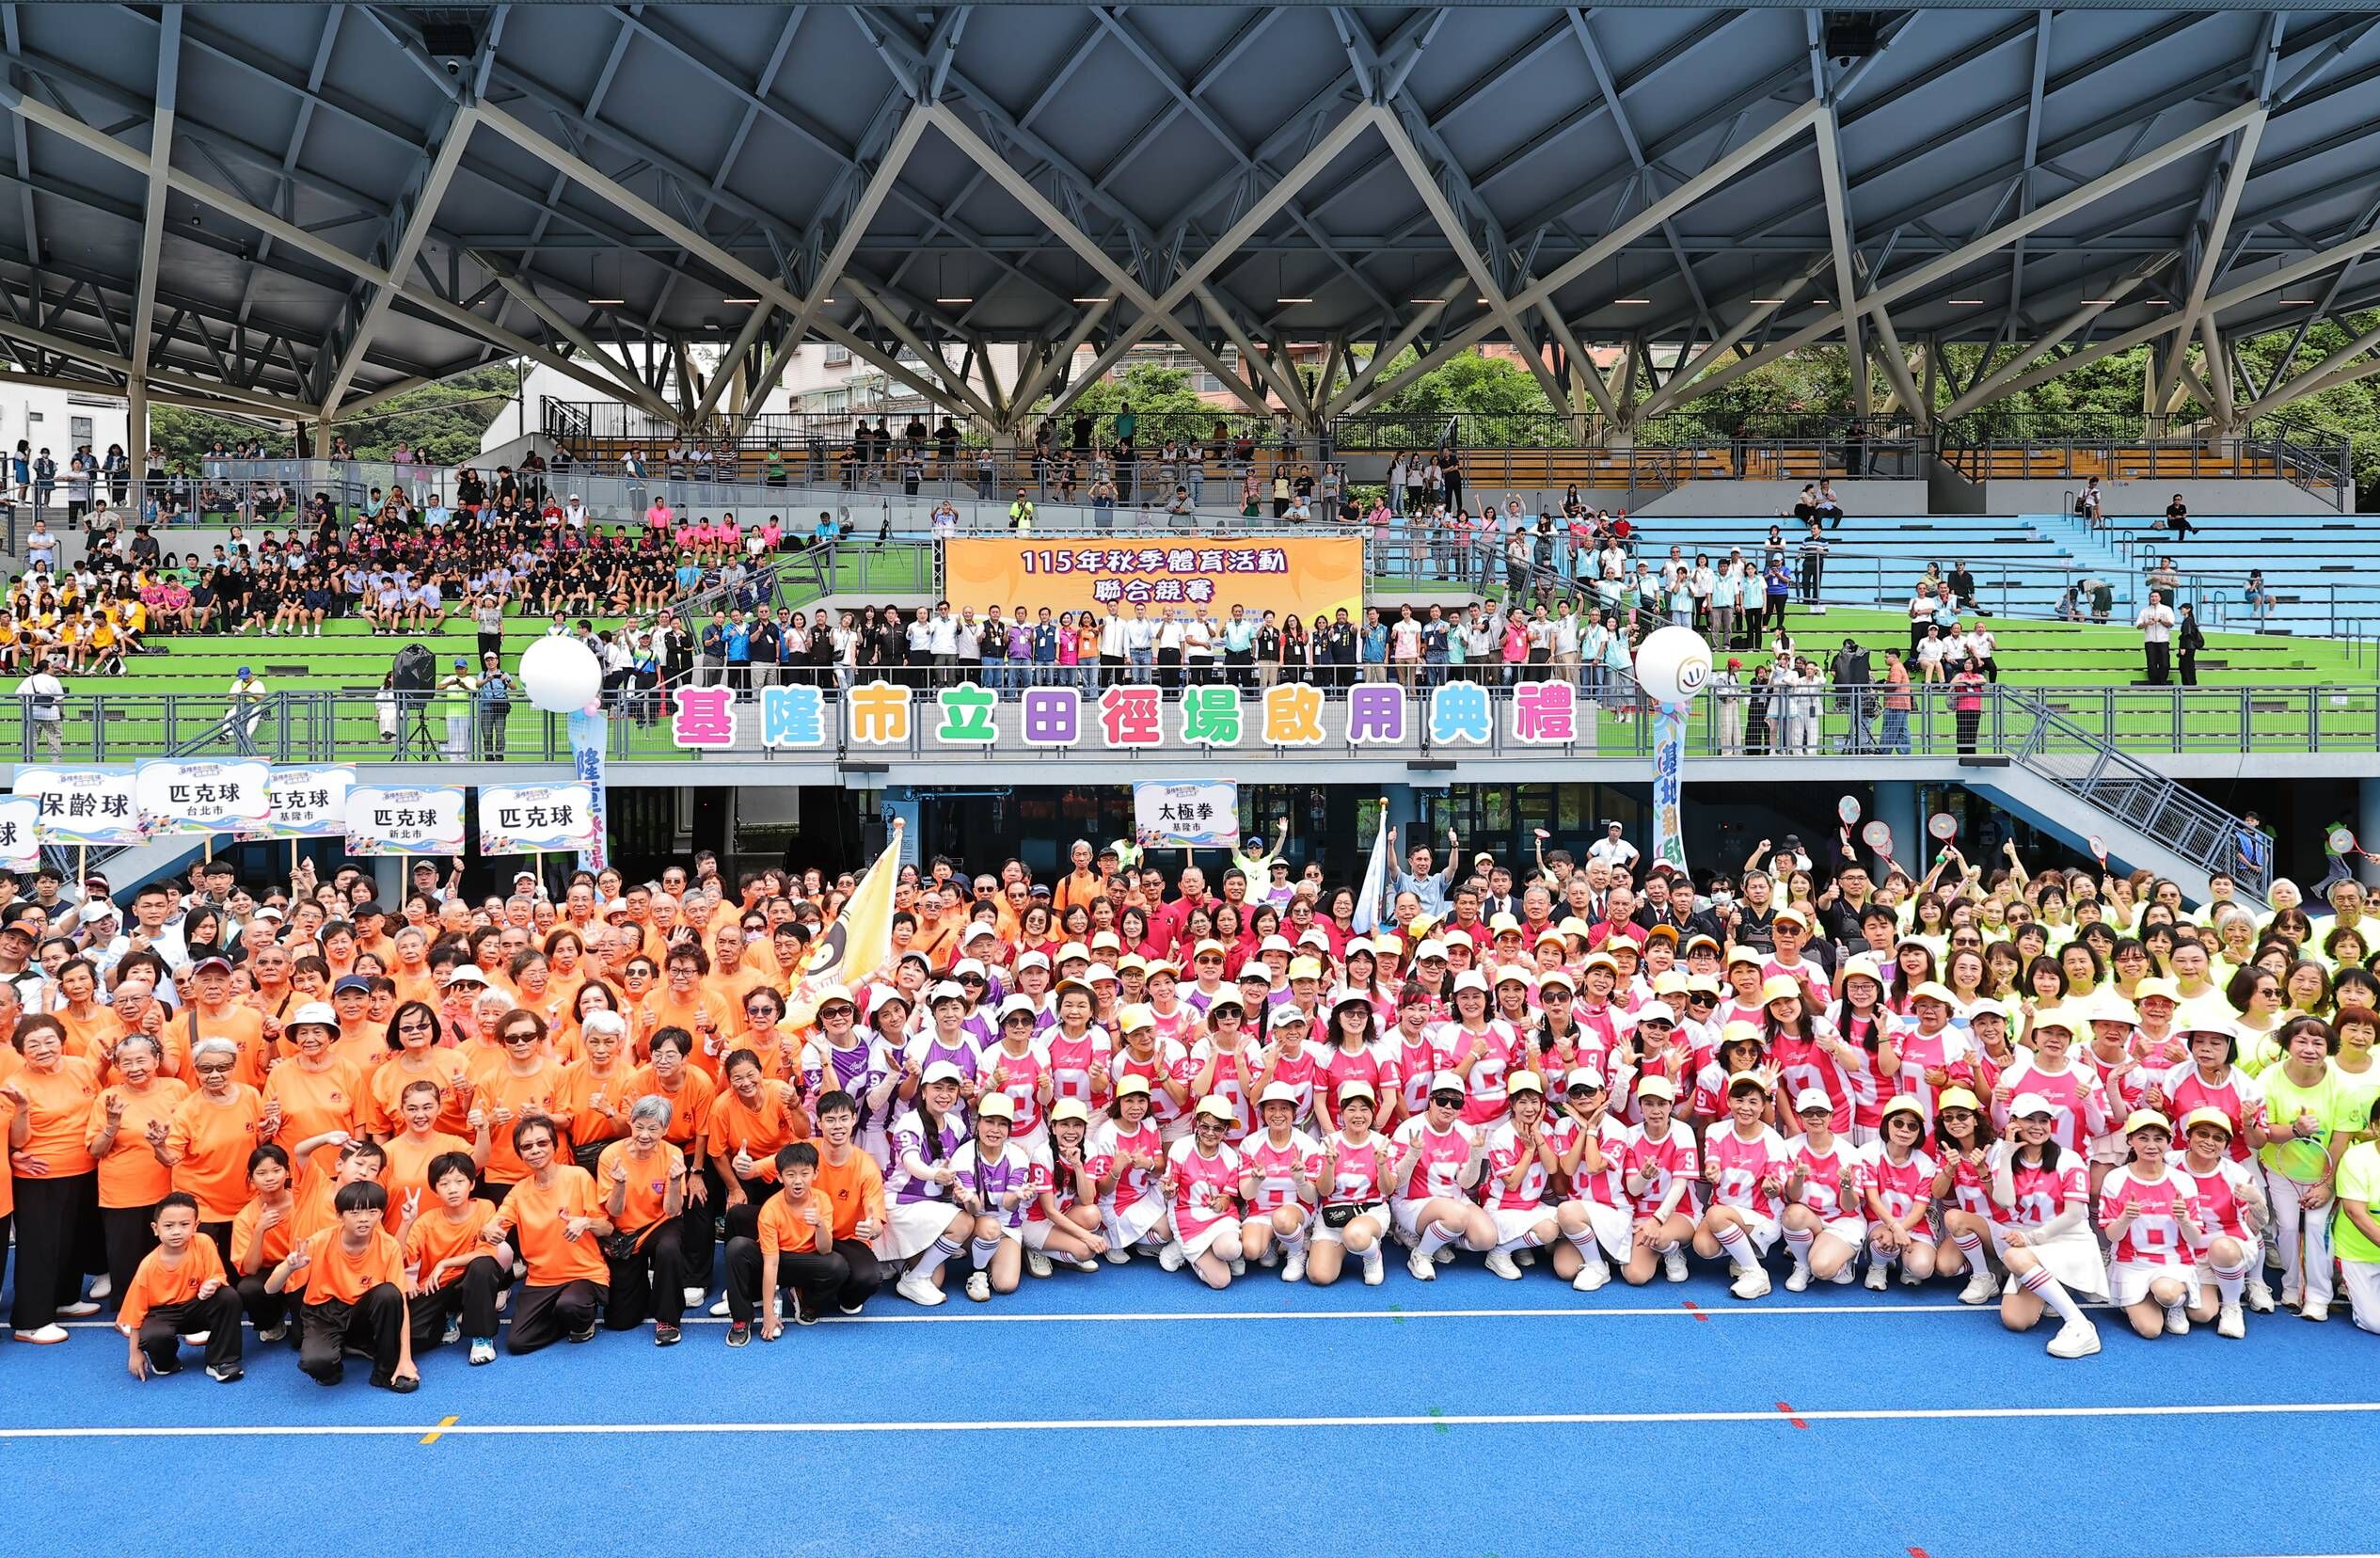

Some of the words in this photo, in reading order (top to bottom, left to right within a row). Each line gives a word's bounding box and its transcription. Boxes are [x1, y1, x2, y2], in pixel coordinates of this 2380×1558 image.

[1021, 548, 1288, 574] 115年秋季體育活動
[1093, 579, 1215, 602] 聯合競賽
[675, 684, 1573, 744] 基隆市立田徑場啟用典禮
[168, 783, 241, 803] 匹克球
[271, 788, 329, 810] 匹克球
[39, 791, 129, 818] 保齡球
[186, 804, 224, 817] 台北市
[1158, 803, 1214, 821] 太極拳
[279, 810, 314, 822] 基隆市
[373, 808, 437, 827] 匹克球
[499, 804, 574, 829] 匹克球
[389, 829, 422, 839] 新北市
[1173, 822, 1201, 833] 基隆市
[1697, 1091, 1706, 1108] 9
[1685, 1151, 1695, 1170] 9
[1035, 1167, 1045, 1184] 9
[2075, 1171, 2086, 1192] 9
